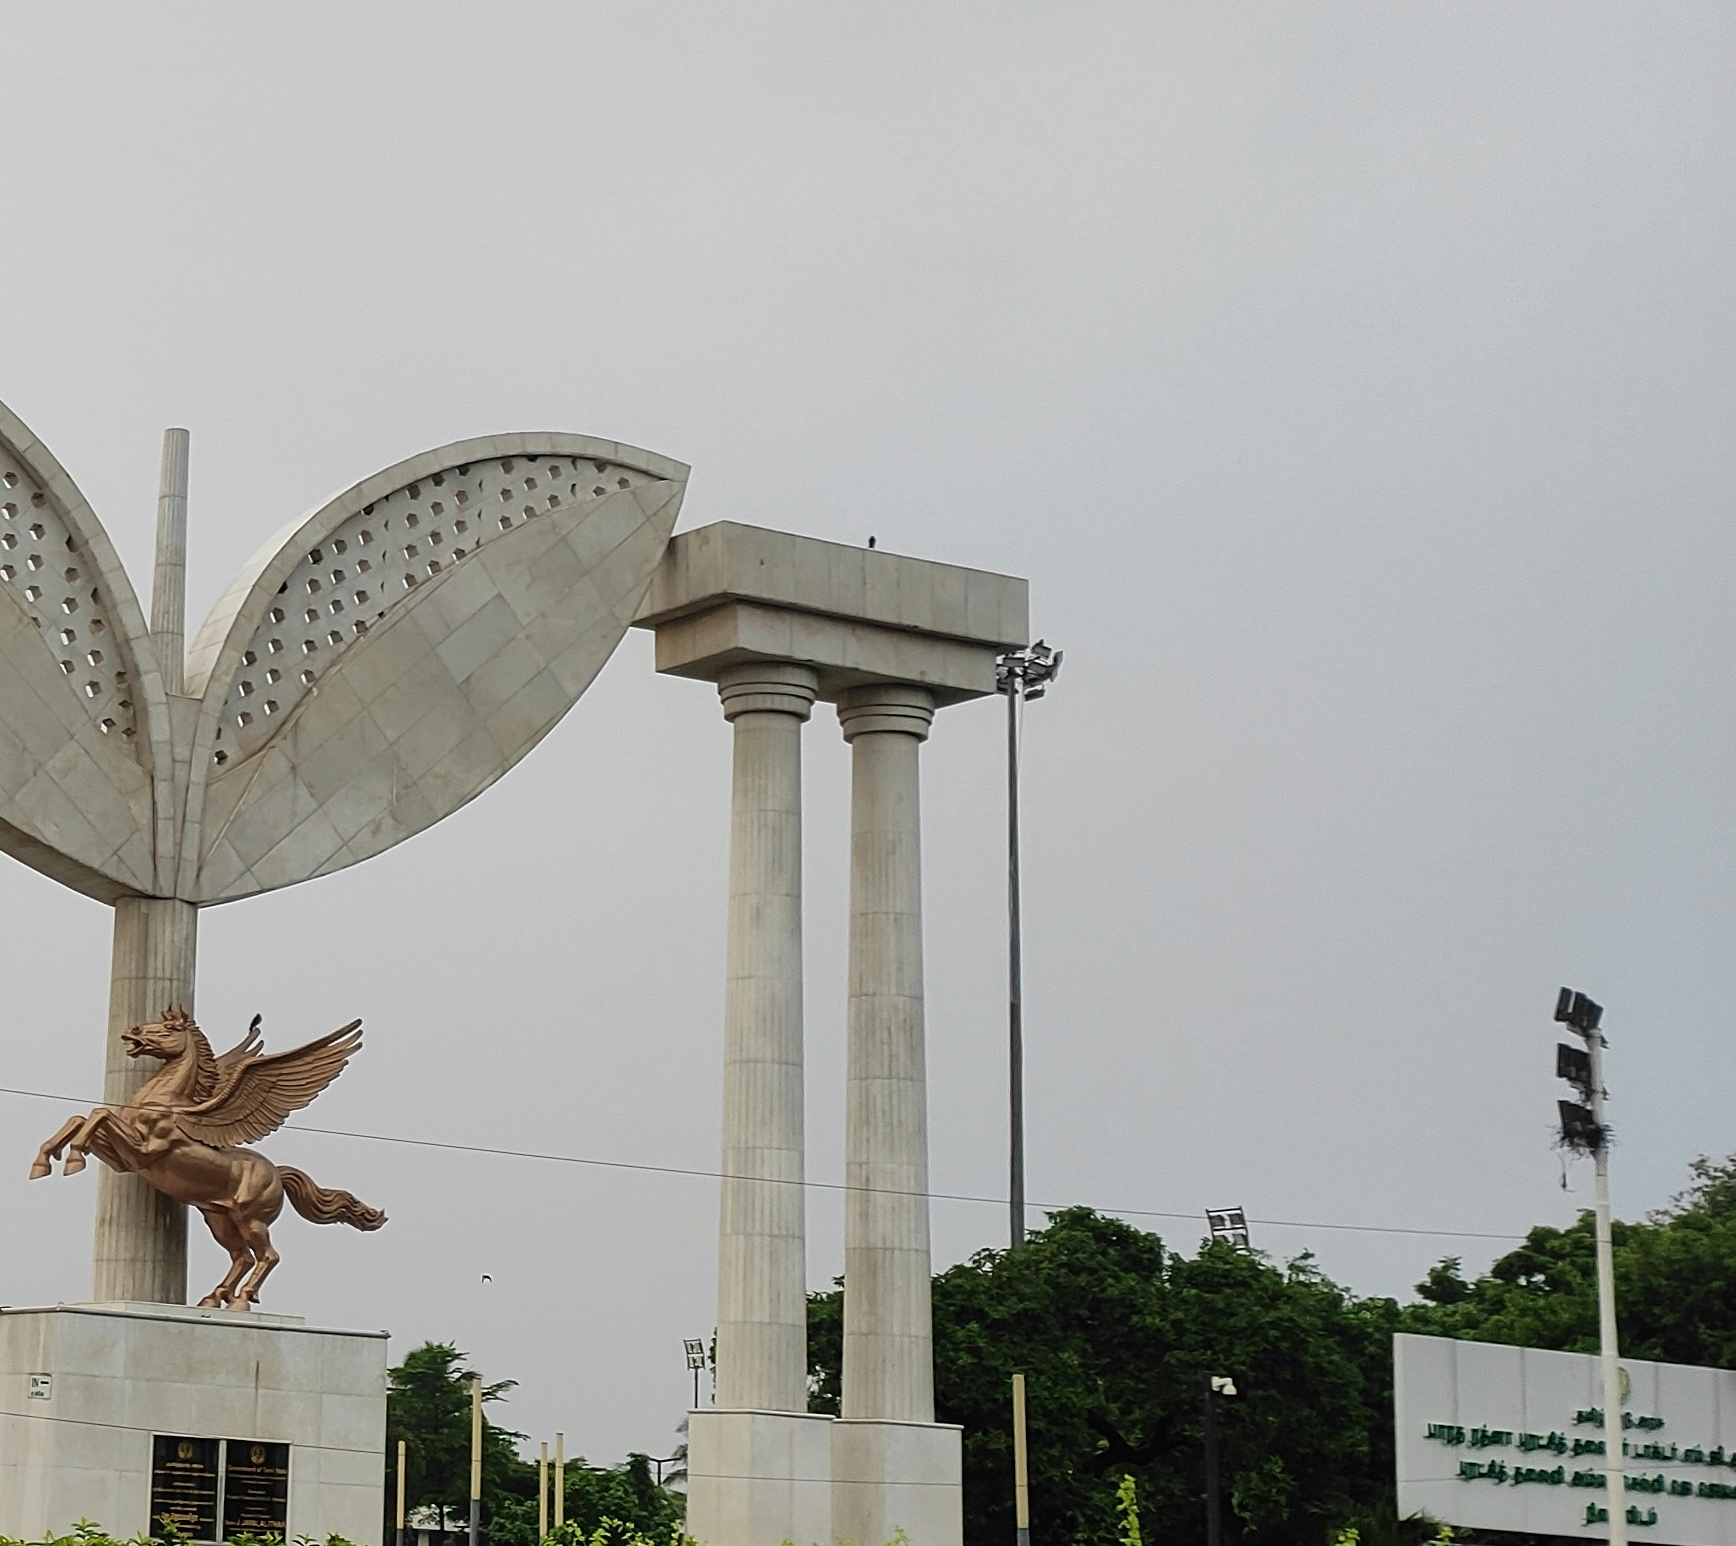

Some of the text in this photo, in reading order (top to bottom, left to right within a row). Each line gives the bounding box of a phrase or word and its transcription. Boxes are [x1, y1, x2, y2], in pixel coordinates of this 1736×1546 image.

[1426, 1423, 1465, 1445] பாரத
[1470, 1423, 1513, 1447] ரத்னா
[1572, 1437, 1629, 1456] தலைர்
